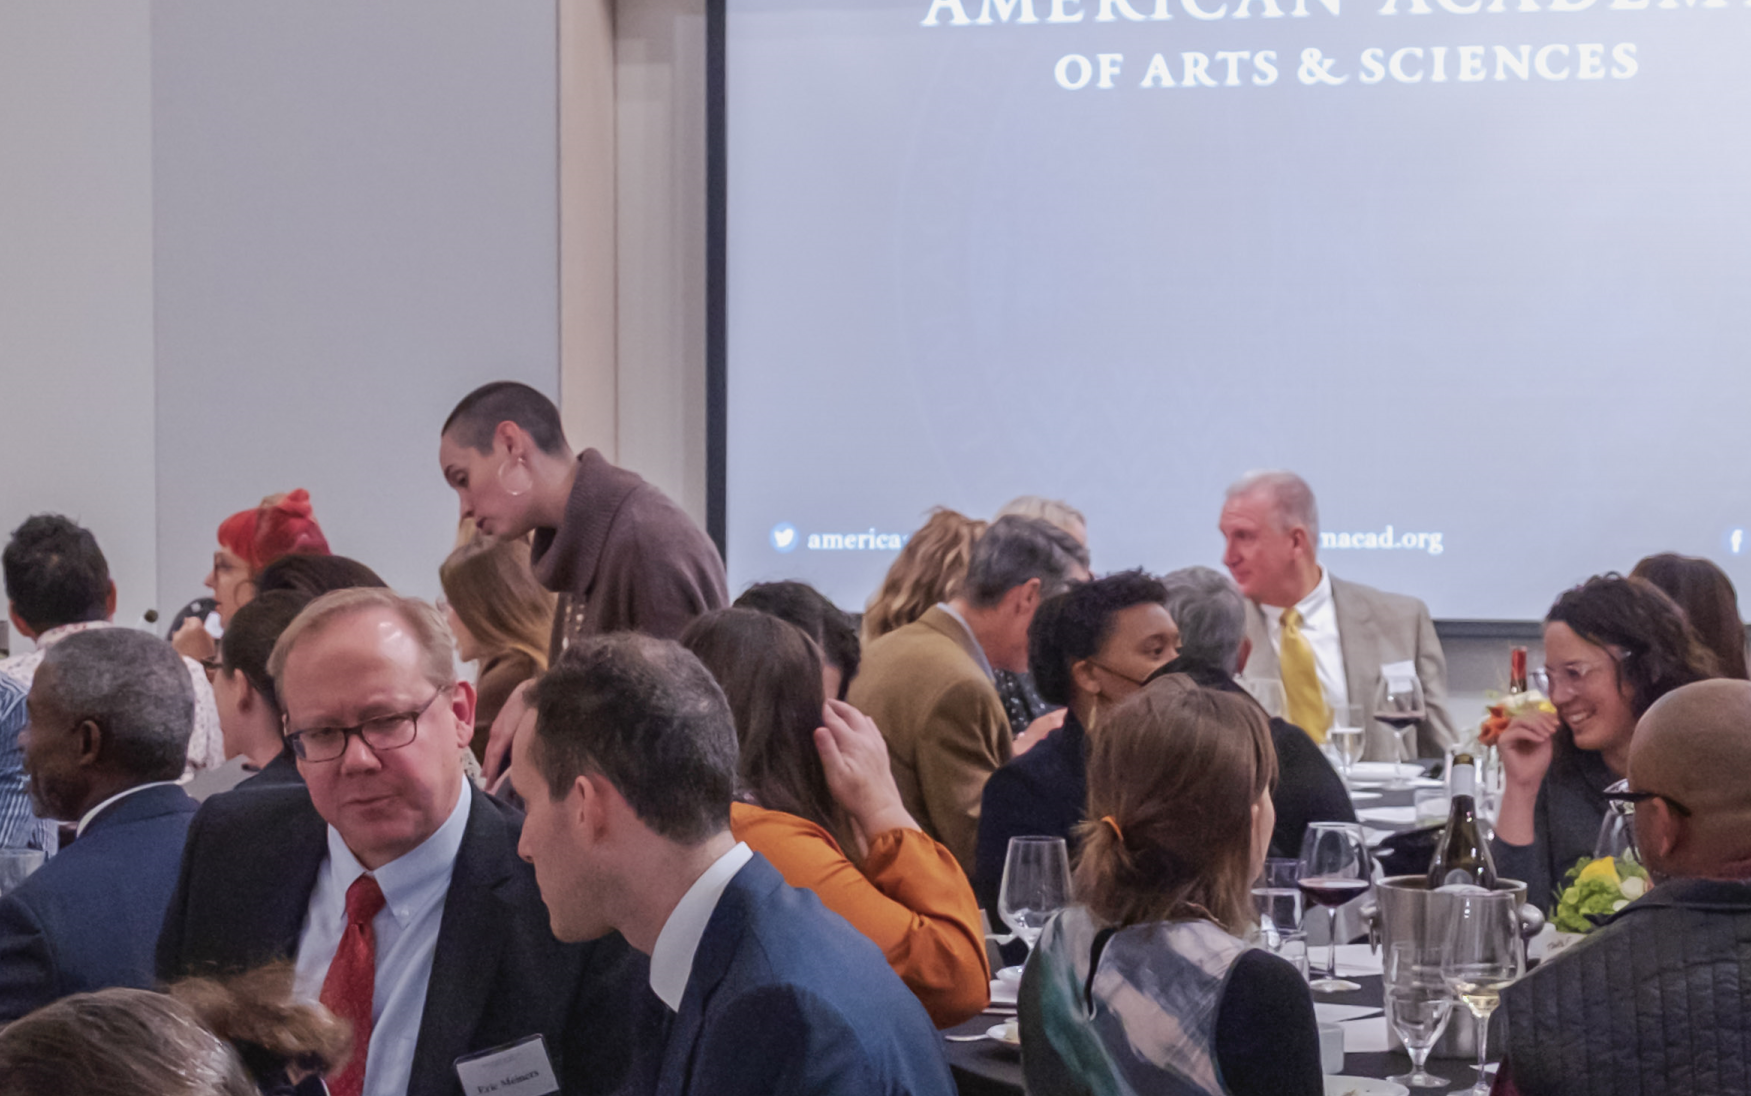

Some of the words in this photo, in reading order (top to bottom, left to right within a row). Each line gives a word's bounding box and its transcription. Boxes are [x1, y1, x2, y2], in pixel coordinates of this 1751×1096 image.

[1053, 53, 1124, 91] OF
[1139, 49, 1279, 89] ARTS
[1296, 46, 1350, 86] &
[1357, 41, 1640, 85] SCIENCES
[807, 527, 906, 550] america
